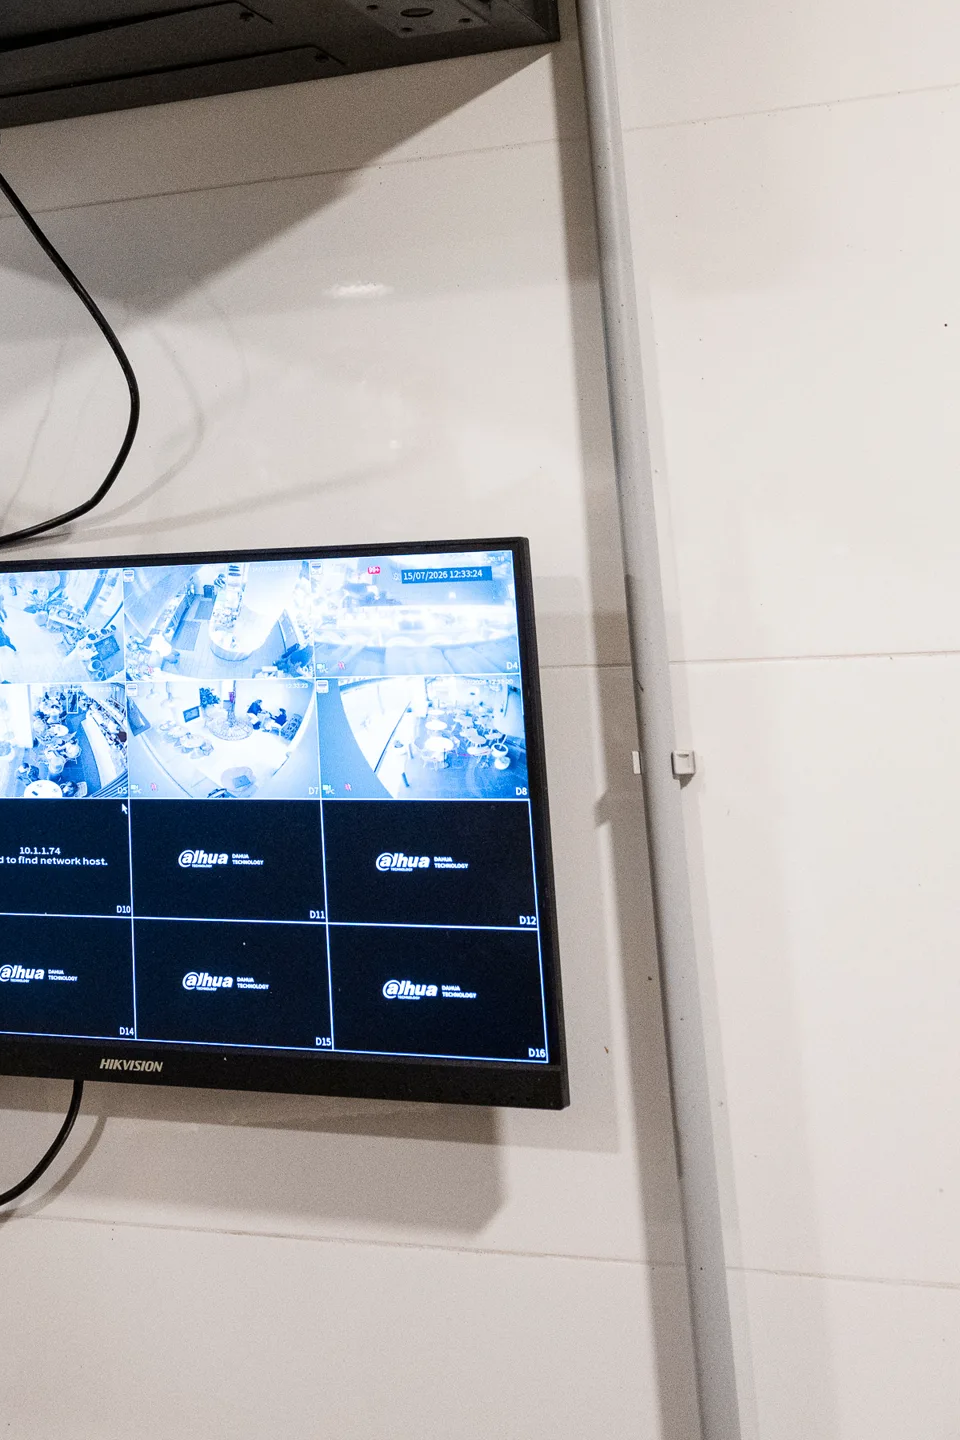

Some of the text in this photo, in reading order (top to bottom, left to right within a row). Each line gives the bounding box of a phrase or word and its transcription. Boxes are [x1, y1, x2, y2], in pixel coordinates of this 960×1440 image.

[403, 568, 483, 581] 15/07/2026 12:33:24
[506, 661, 518, 670] D4
[308, 787, 319, 795] D7
[515, 787, 528, 796] D8
[19, 846, 61, 855] 10.1.1.74
[6, 856, 16, 864] to
[18, 855, 38, 865] find
[40, 856, 81, 865] network
[82, 857, 108, 866] host.
[116, 905, 131, 913] D10
[309, 910, 325, 919] D11
[519, 915, 536, 925] D12
[119, 1027, 134, 1036] D14
[315, 1037, 331, 1046] D15
[528, 1048, 546, 1058] D16
[99, 1058, 163, 1072] HIKVISION
